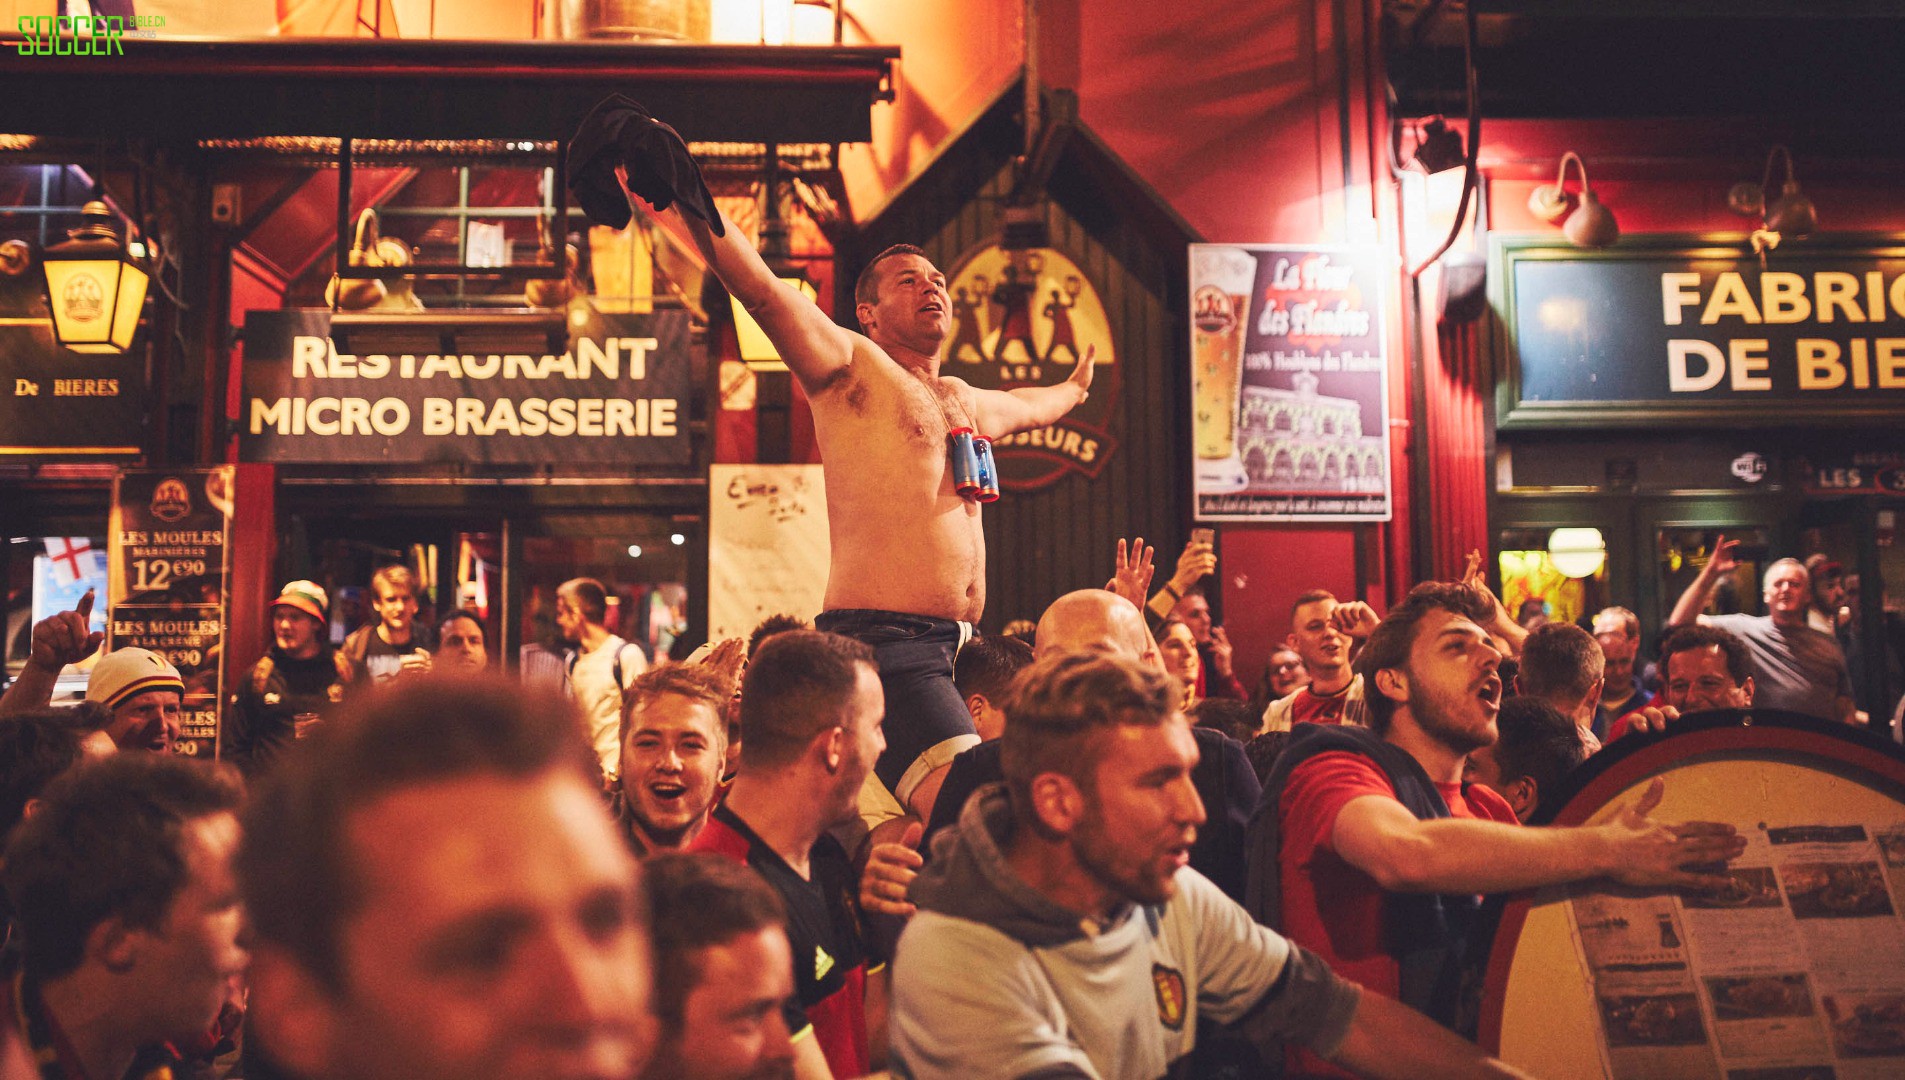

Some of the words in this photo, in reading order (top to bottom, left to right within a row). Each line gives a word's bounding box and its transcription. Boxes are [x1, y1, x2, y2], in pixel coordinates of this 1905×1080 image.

[1000, 365, 1042, 380] LES
[1667, 338, 1772, 392] DE
[15, 379, 39, 396] De
[54, 379, 119, 396] BIERES
[250, 397, 411, 436] MICRO
[422, 398, 678, 437] BRASSERIE
[1820, 469, 1861, 488] LES
[119, 531, 148, 545] LES
[153, 531, 222, 545] MOULES
[114, 621, 144, 635] LES
[149, 621, 219, 635] MOULES
